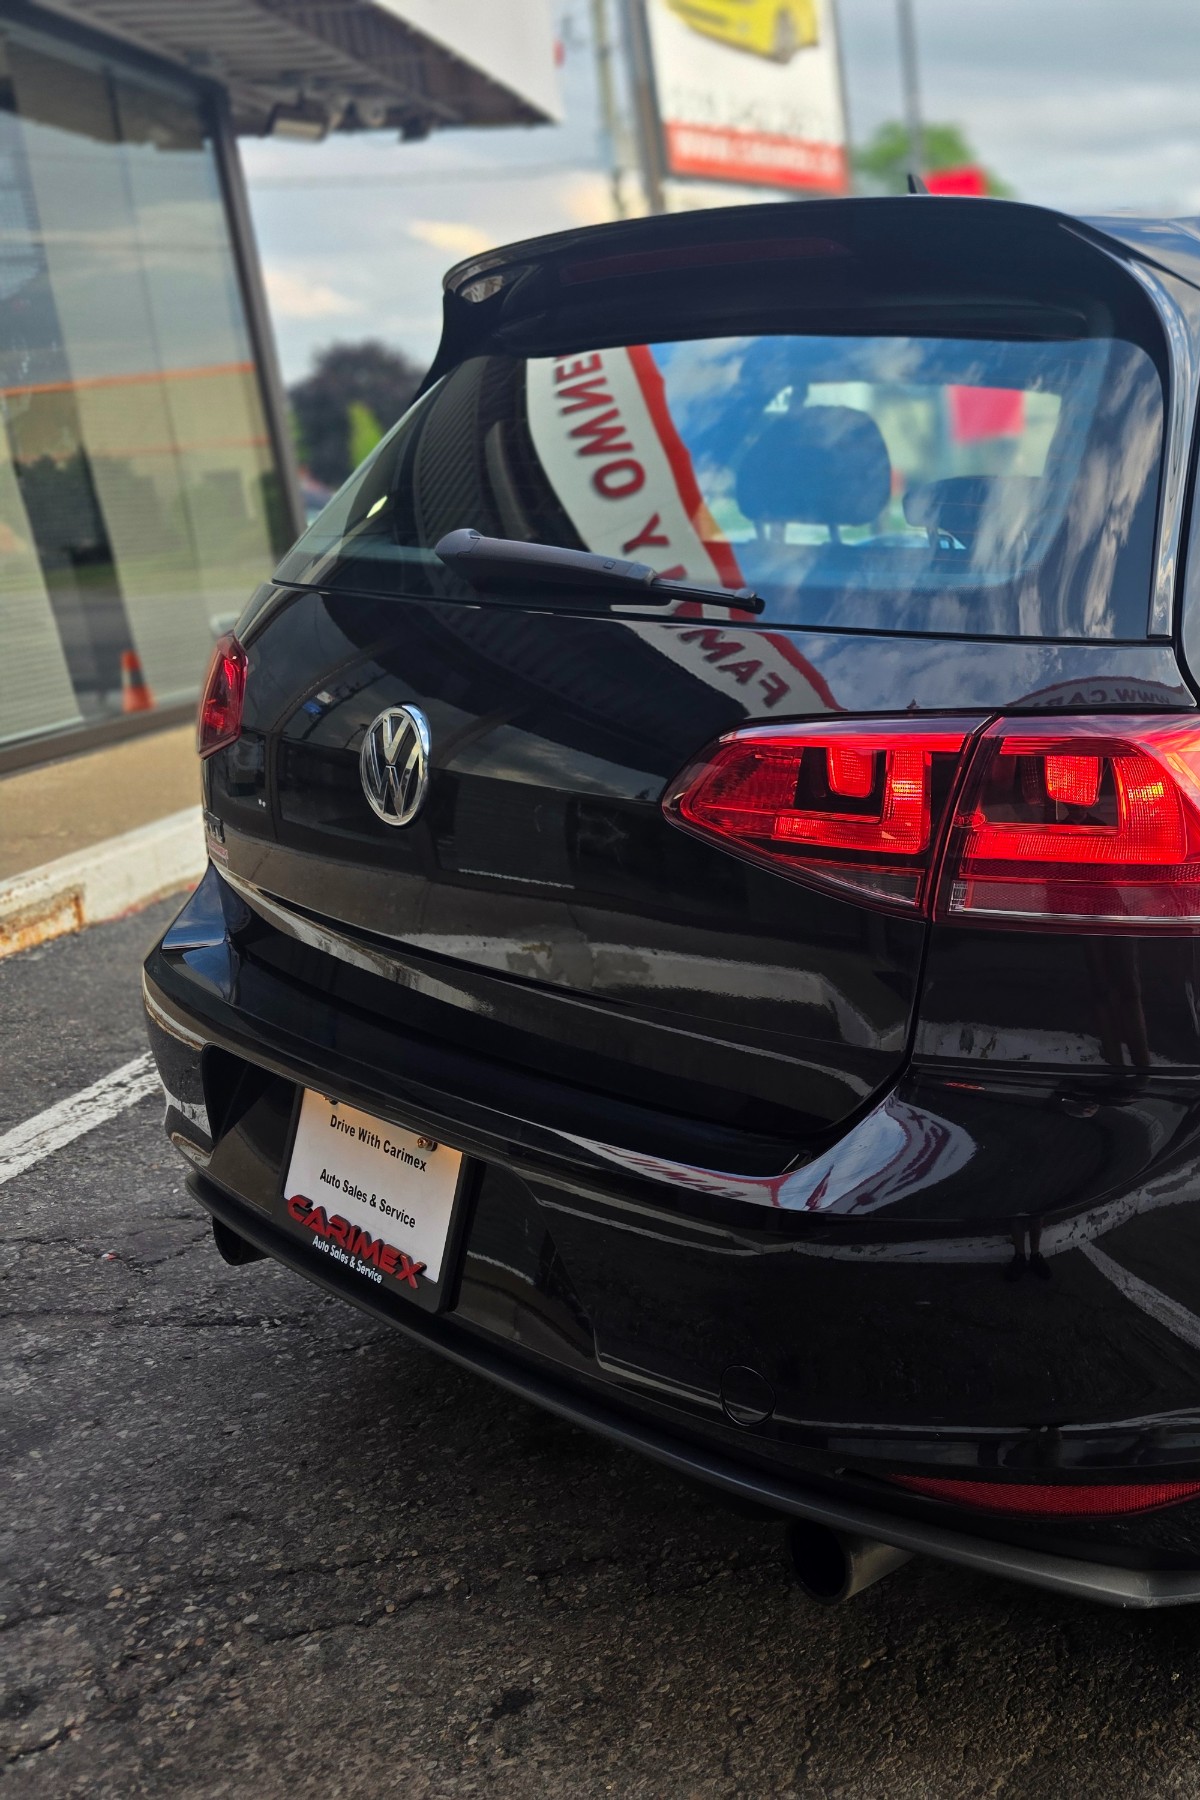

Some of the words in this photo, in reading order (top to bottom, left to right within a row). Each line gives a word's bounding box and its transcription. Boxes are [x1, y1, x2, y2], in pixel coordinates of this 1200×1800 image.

[330, 1114, 355, 1136] Drive
[358, 1128, 380, 1149] With
[383, 1139, 426, 1171] Carimex
[320, 1168, 340, 1188] Auto
[342, 1179, 367, 1202] Sales
[369, 1193, 376, 1207] &
[379, 1199, 415, 1227] Service
[287, 1194, 426, 1288] CARIMEX
[312, 1235, 329, 1253] Auto
[330, 1244, 348, 1265] Sales
[349, 1255, 355, 1269] &
[356, 1259, 382, 1283] Service
